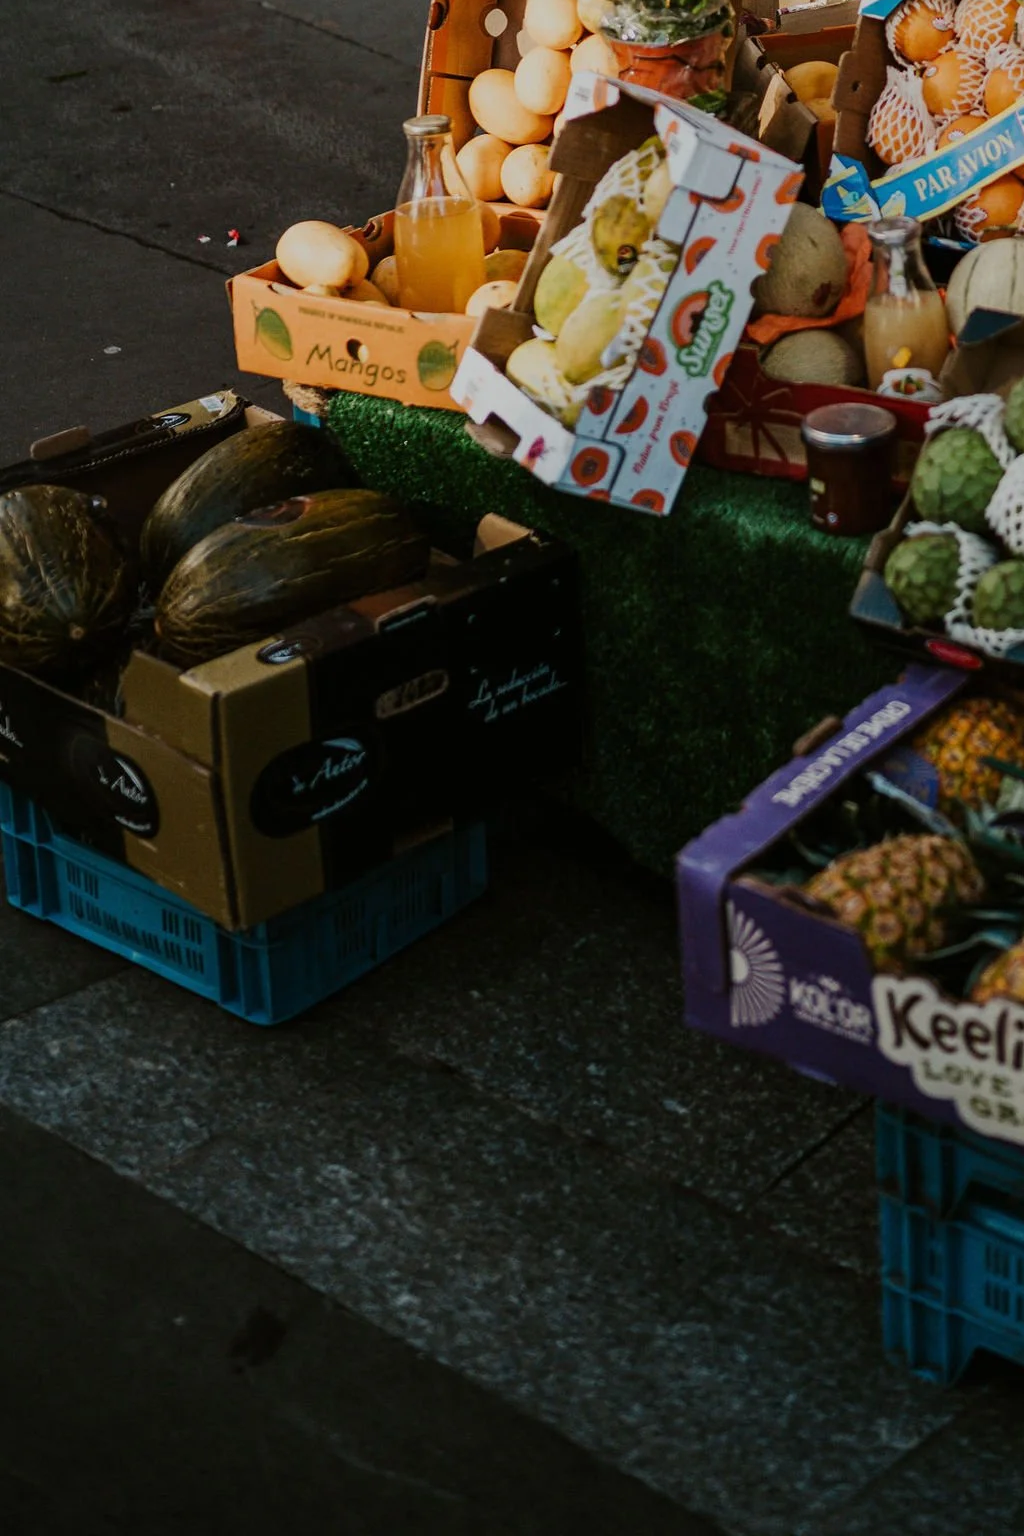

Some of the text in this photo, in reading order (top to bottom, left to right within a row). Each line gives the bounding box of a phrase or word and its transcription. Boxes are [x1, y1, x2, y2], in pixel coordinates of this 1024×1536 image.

[913, 165, 957, 202] PAR
[957, 129, 1017, 182] AVION
[680, 283, 731, 373] Sunset
[306, 343, 407, 387] Mangos
[922, 1059, 1014, 1099] LOVE
